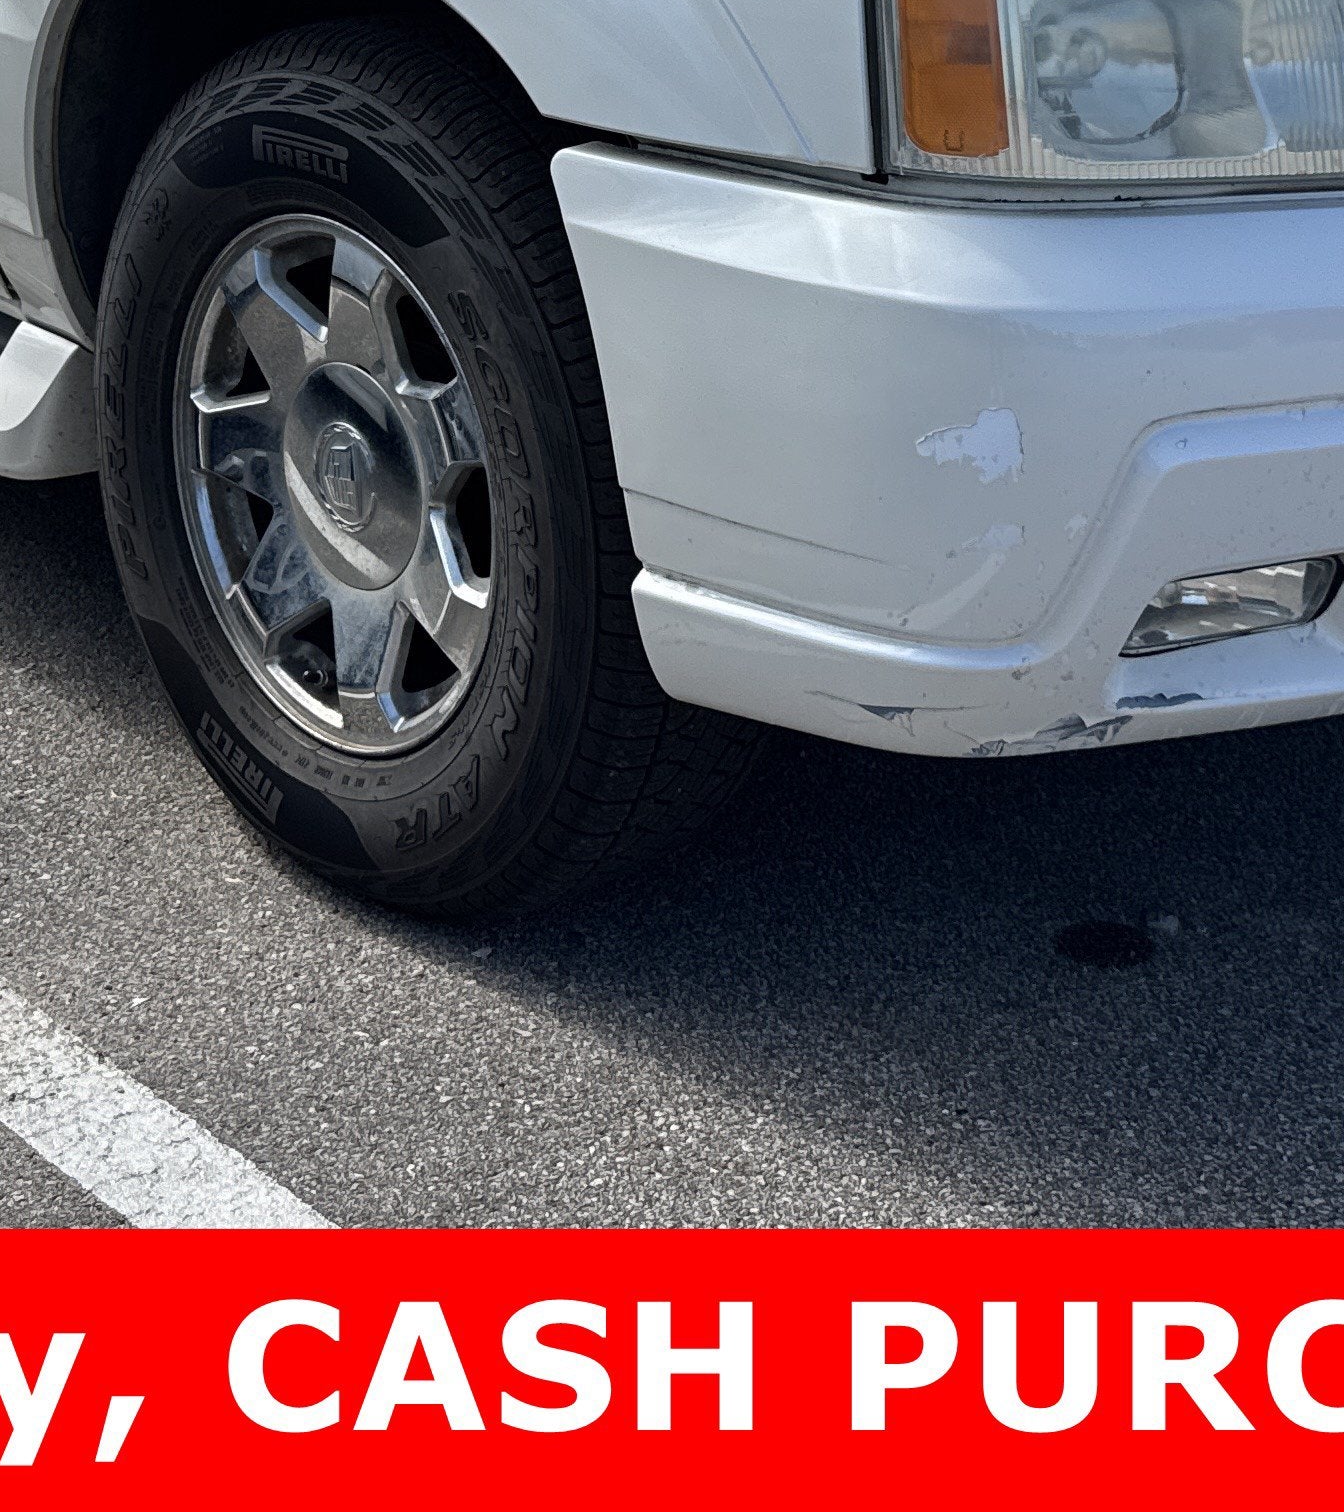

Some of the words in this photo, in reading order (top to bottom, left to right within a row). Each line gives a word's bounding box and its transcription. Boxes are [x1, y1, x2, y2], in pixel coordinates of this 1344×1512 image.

[252, 124, 349, 184] PIRELLI
[103, 252, 149, 580] PIRELLI
[449, 291, 540, 762] SCORPION
[197, 711, 284, 826] PIRELLI
[395, 754, 480, 851] ATR
